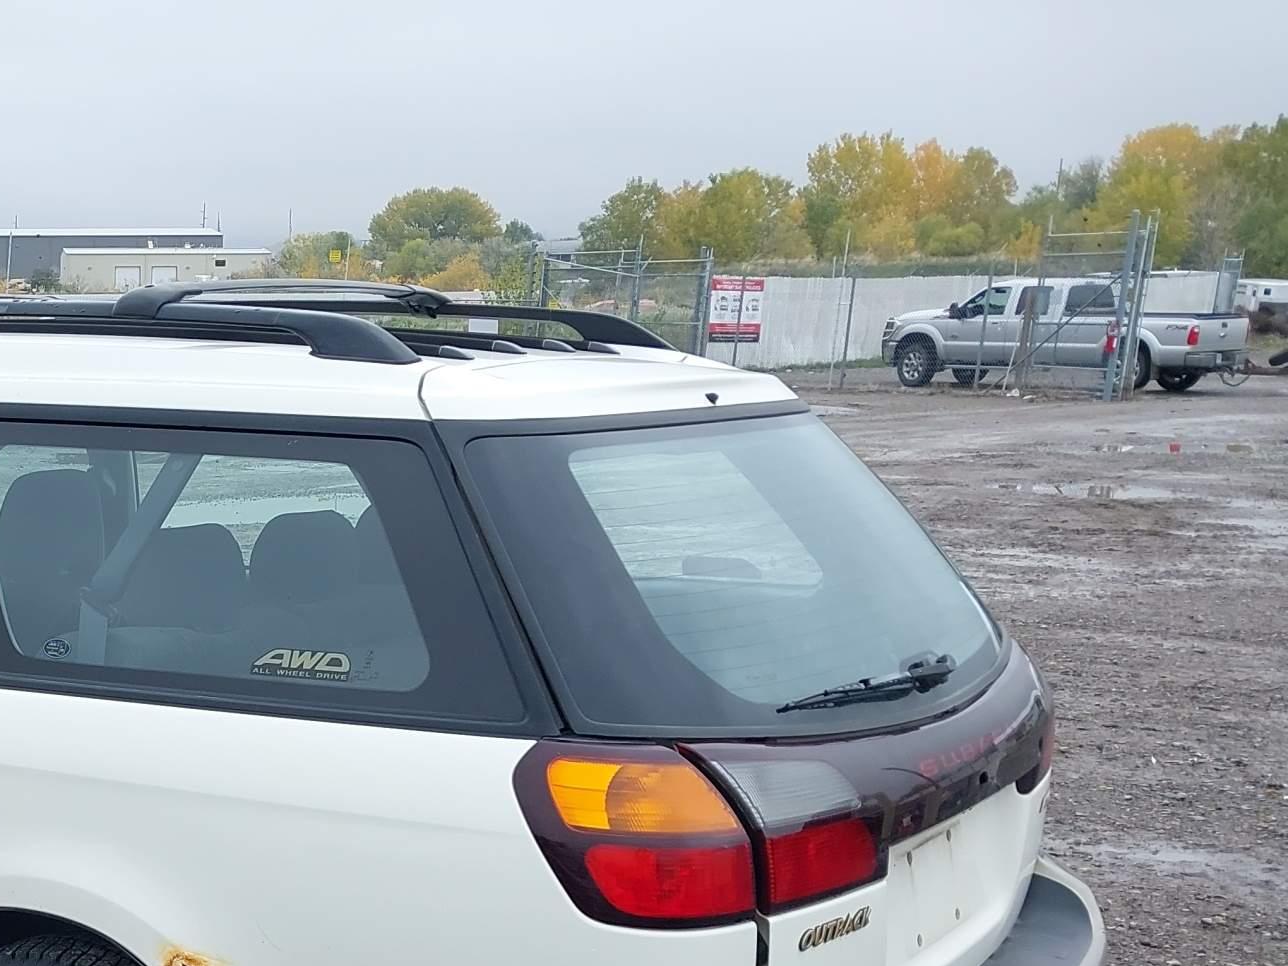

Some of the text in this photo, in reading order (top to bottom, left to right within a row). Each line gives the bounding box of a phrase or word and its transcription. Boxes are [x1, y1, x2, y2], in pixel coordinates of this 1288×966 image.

[253, 649, 351, 673] AWD
[252, 667, 348, 681] ALL WHEEL DRIVE
[798, 905, 871, 952] OUTBACK
